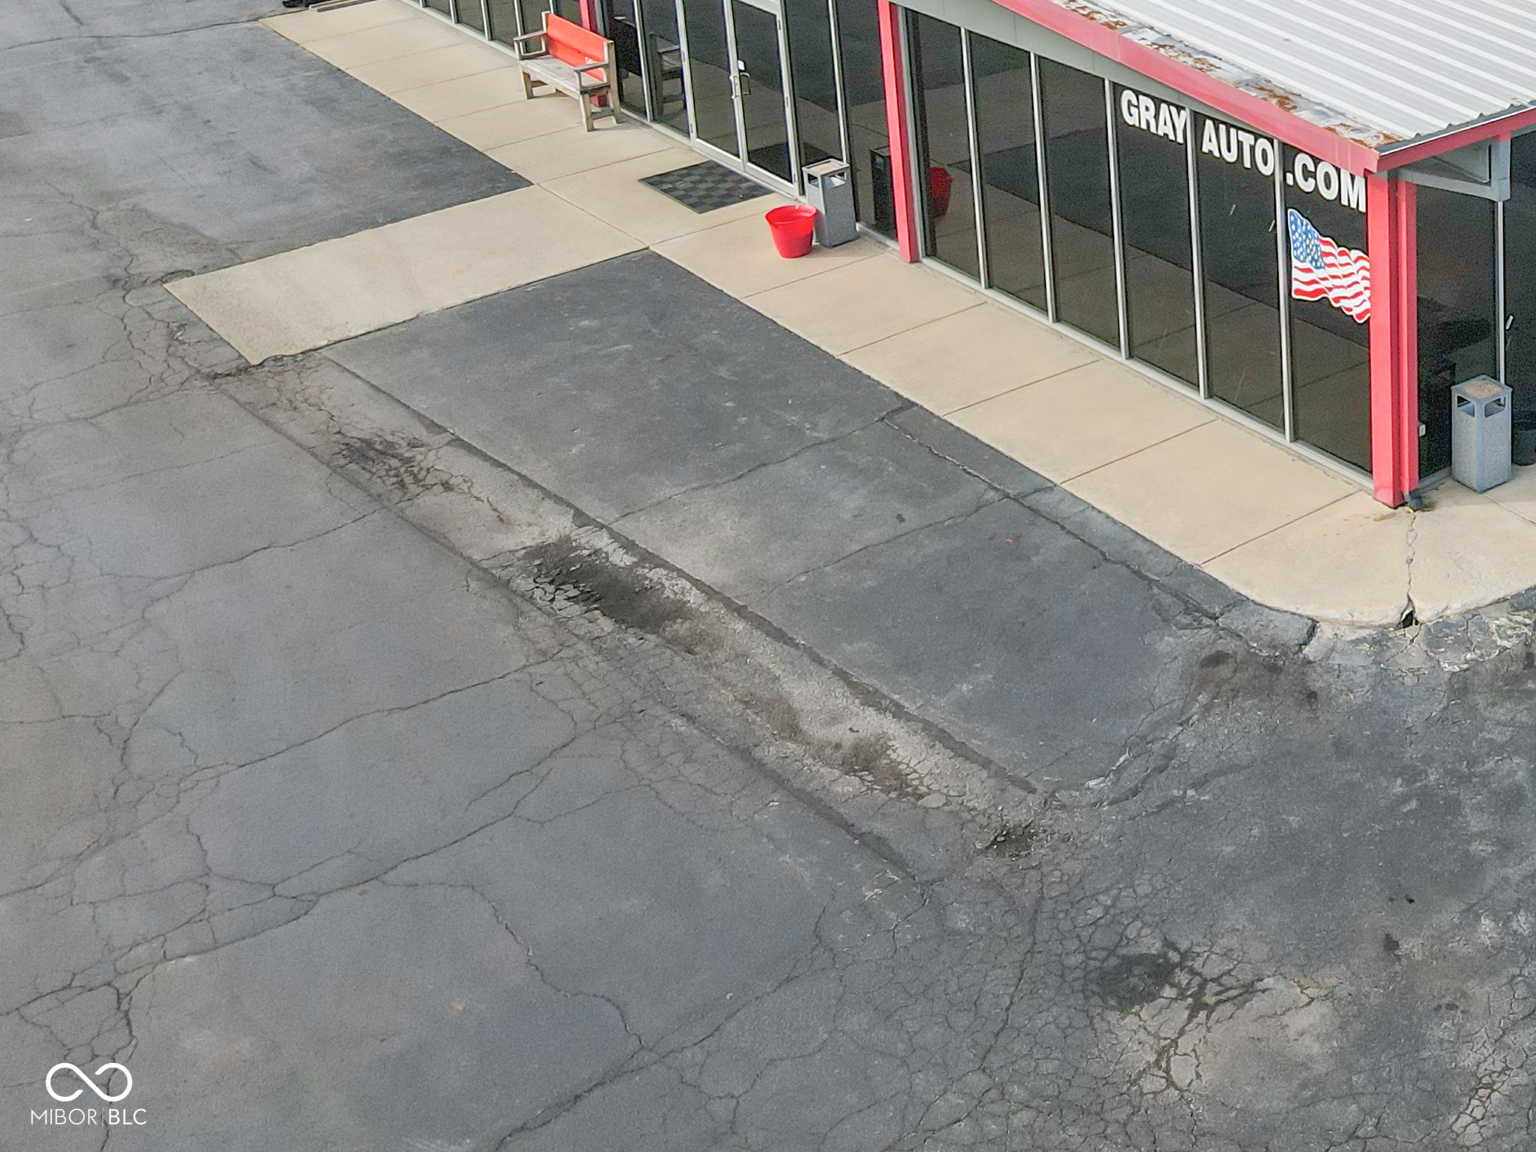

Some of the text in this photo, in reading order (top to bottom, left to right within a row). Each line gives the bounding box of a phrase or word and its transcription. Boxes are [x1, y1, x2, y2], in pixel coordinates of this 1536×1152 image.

[1120, 88, 1367, 213] GRAY AUTO .COM
